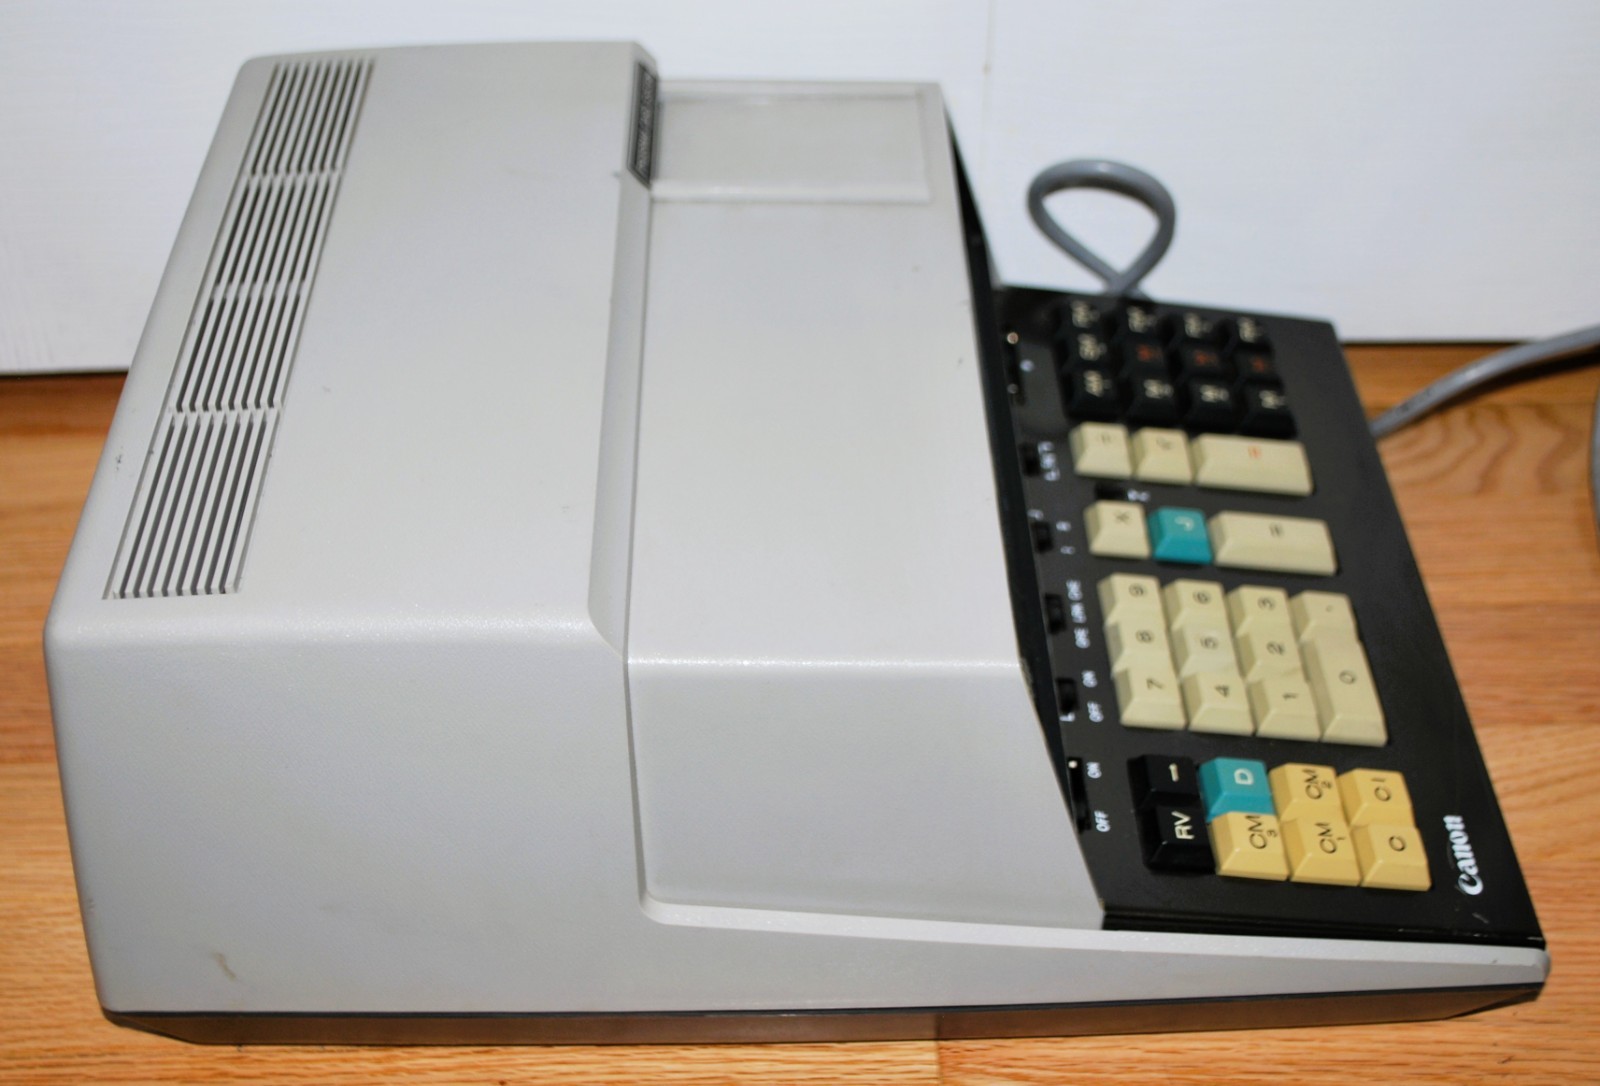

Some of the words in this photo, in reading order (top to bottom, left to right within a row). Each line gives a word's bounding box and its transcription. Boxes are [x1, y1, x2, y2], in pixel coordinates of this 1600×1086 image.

[1128, 583, 1147, 597] 9
[1192, 591, 1211, 604] 6
[1258, 596, 1276, 610] 3
[1135, 629, 1154, 643] 8
[1200, 637, 1218, 650] 5
[1266, 642, 1285, 656] 2
[1146, 677, 1164, 690] 7
[1214, 685, 1231, 698] 4
[1282, 692, 1298, 701] 1
[1233, 768, 1254, 786] D
[1304, 768, 1323, 800] CM
[1320, 780, 1333, 790] 2
[1094, 810, 1111, 833] OFF
[1171, 811, 1195, 840] RV
[1245, 814, 1268, 850] CM
[1265, 828, 1279, 838] 3
[1319, 821, 1338, 854] CM
[1388, 836, 1407, 853] C
[1443, 815, 1484, 896] Canon
